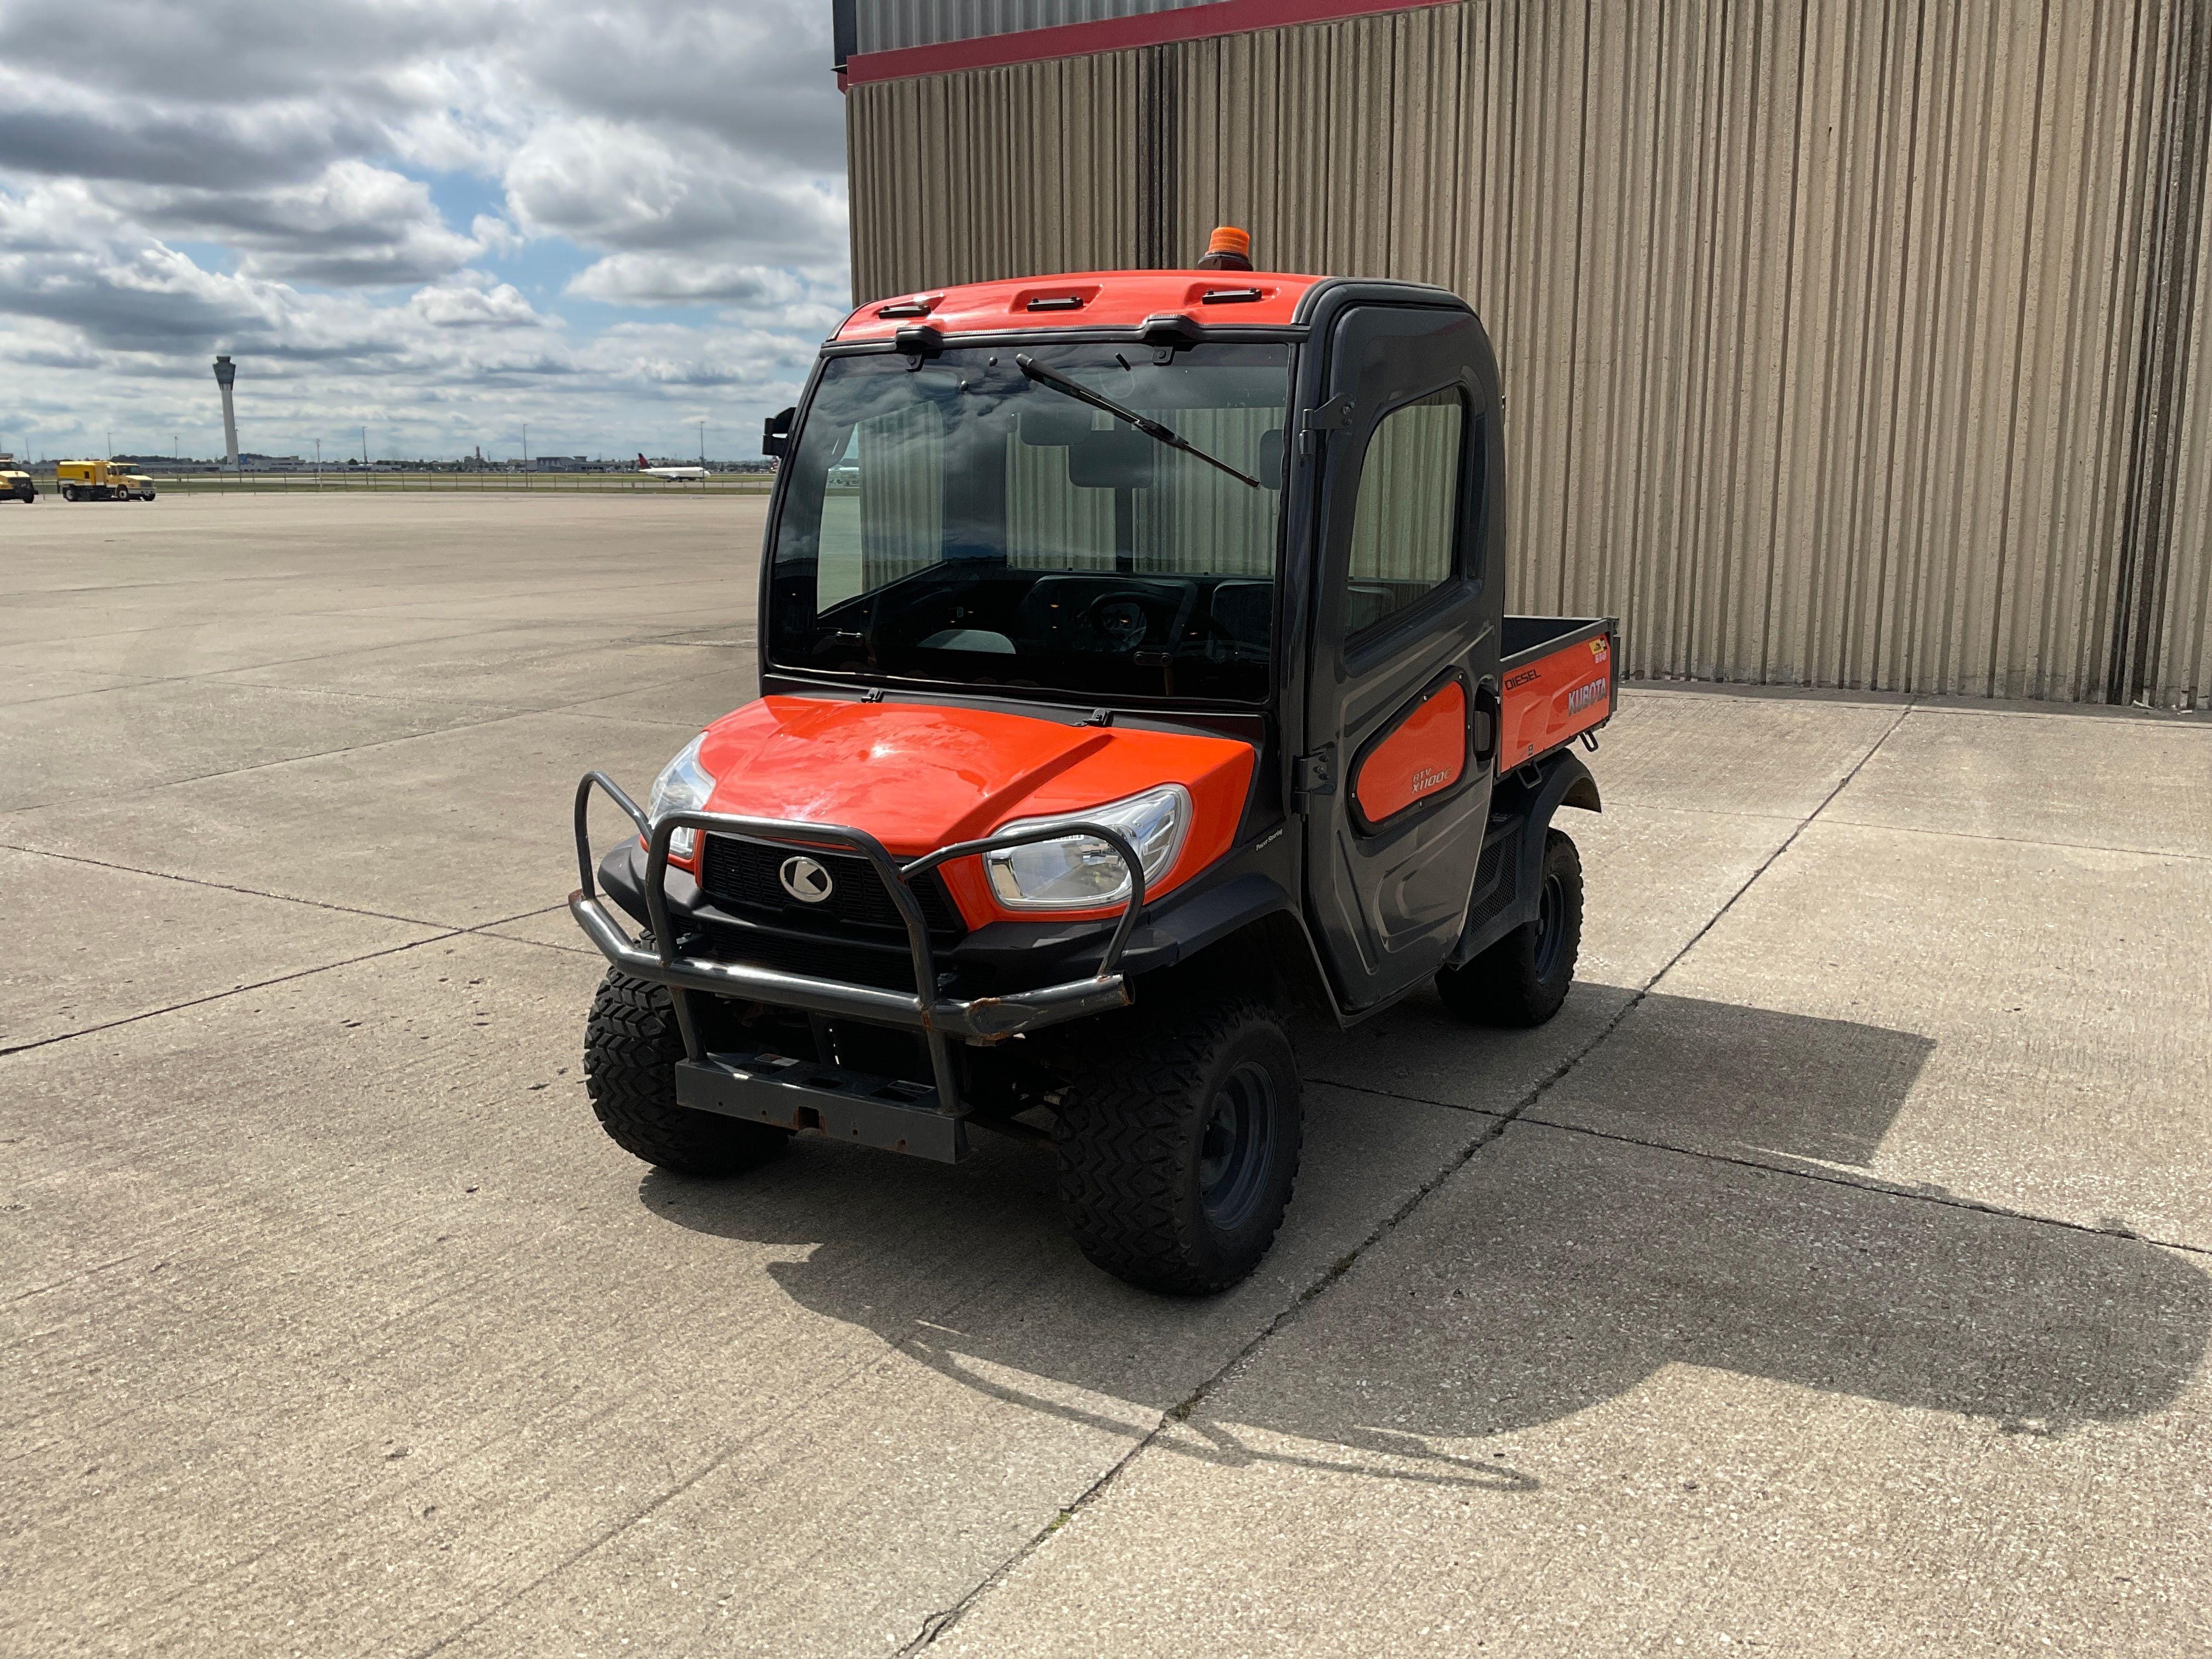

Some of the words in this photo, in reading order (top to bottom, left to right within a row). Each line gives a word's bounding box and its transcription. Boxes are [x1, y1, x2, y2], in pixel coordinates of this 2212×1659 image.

[1505, 669, 1541, 690] DIESEL
[1568, 676, 1607, 716] KUBOTA
[1413, 767, 1431, 782] RTV
